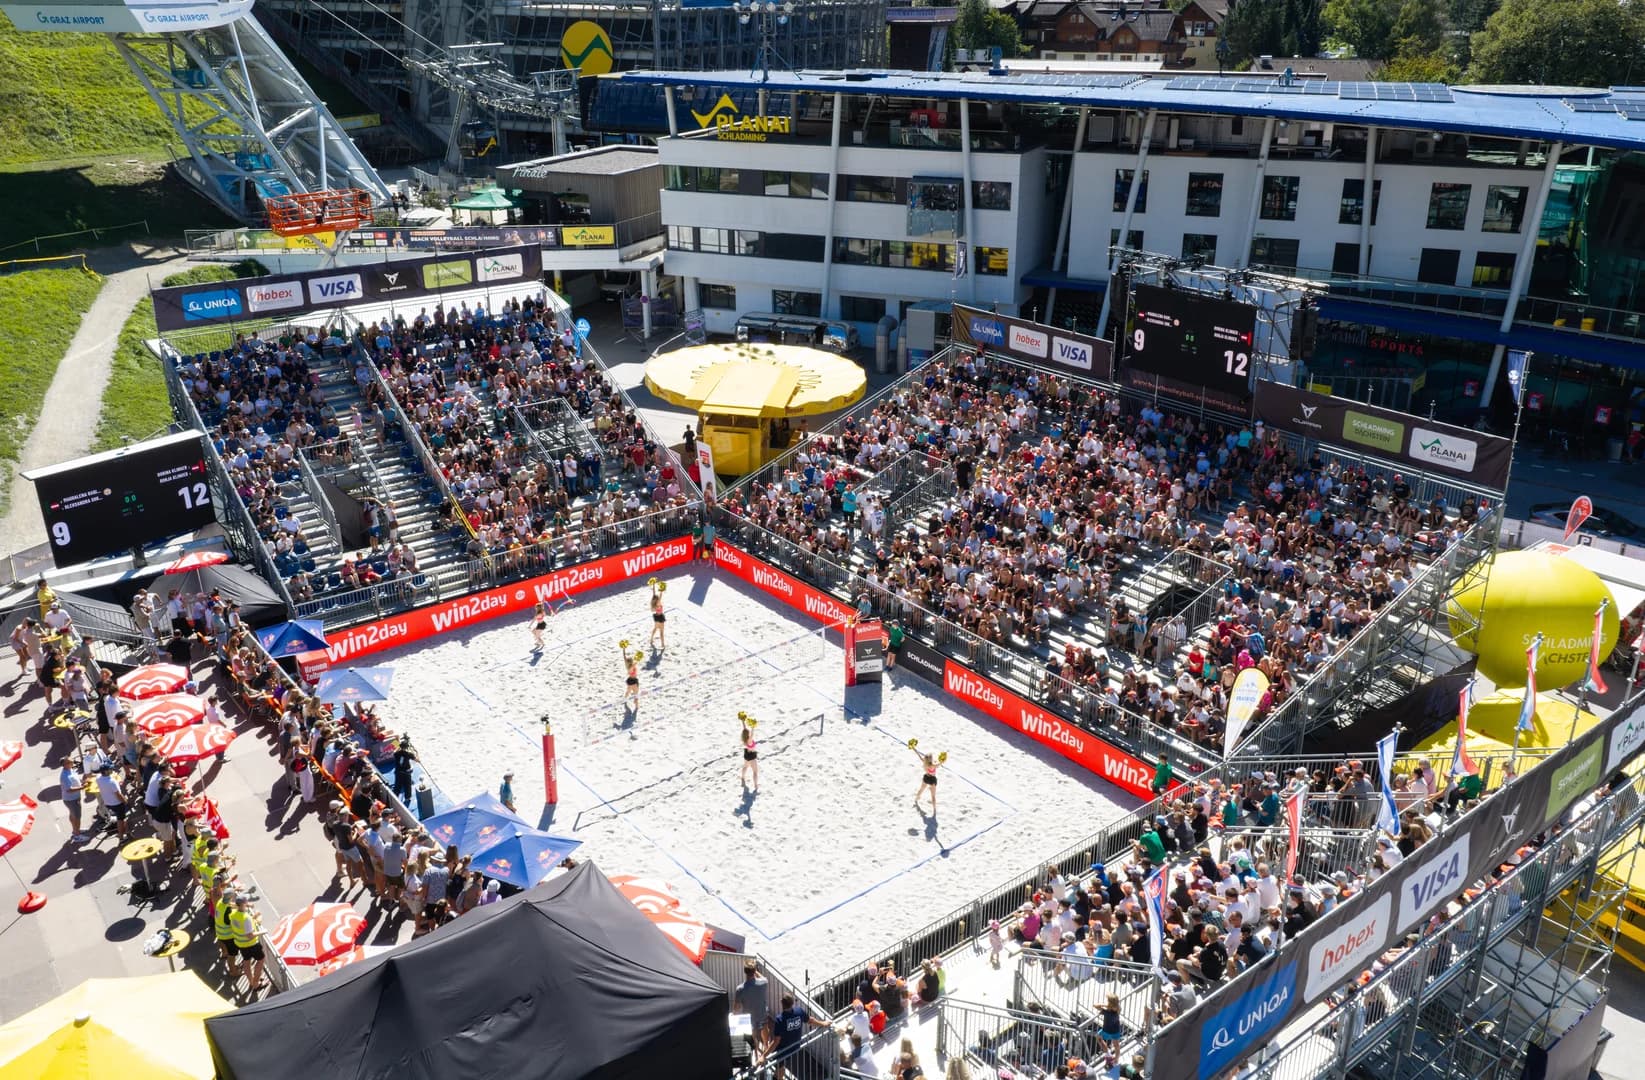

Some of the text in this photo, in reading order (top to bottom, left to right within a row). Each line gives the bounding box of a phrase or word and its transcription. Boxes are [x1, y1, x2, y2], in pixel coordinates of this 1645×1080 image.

[50, 16, 105, 24] GRAZ AIRPORT
[157, 13, 209, 23] GRAZ AIRPORT
[716, 114, 791, 133] PLANAI
[717, 132, 767, 142] SCHLADMING
[492, 264, 517, 273] PLANAI
[256, 289, 292, 301] hobex
[316, 280, 357, 297] VISA
[203, 298, 238, 310] UNIQA
[982, 327, 1002, 338] UNIQA
[1015, 332, 1041, 348] hobex
[1134, 329, 1145, 351] 9
[1059, 343, 1088, 363] VISA
[1224, 350, 1248, 377] 12
[1430, 446, 1467, 461] PLANAI
[177, 482, 210, 510] 12
[52, 521, 71, 546] 9
[714, 543, 742, 568] in2day
[304, 662, 328, 673] Kronen
[906, 651, 943, 675] SCHLADMING
[1411, 851, 1459, 912] VISA
[1320, 919, 1377, 973] hobex
[1239, 985, 1289, 1035] UNIQA
